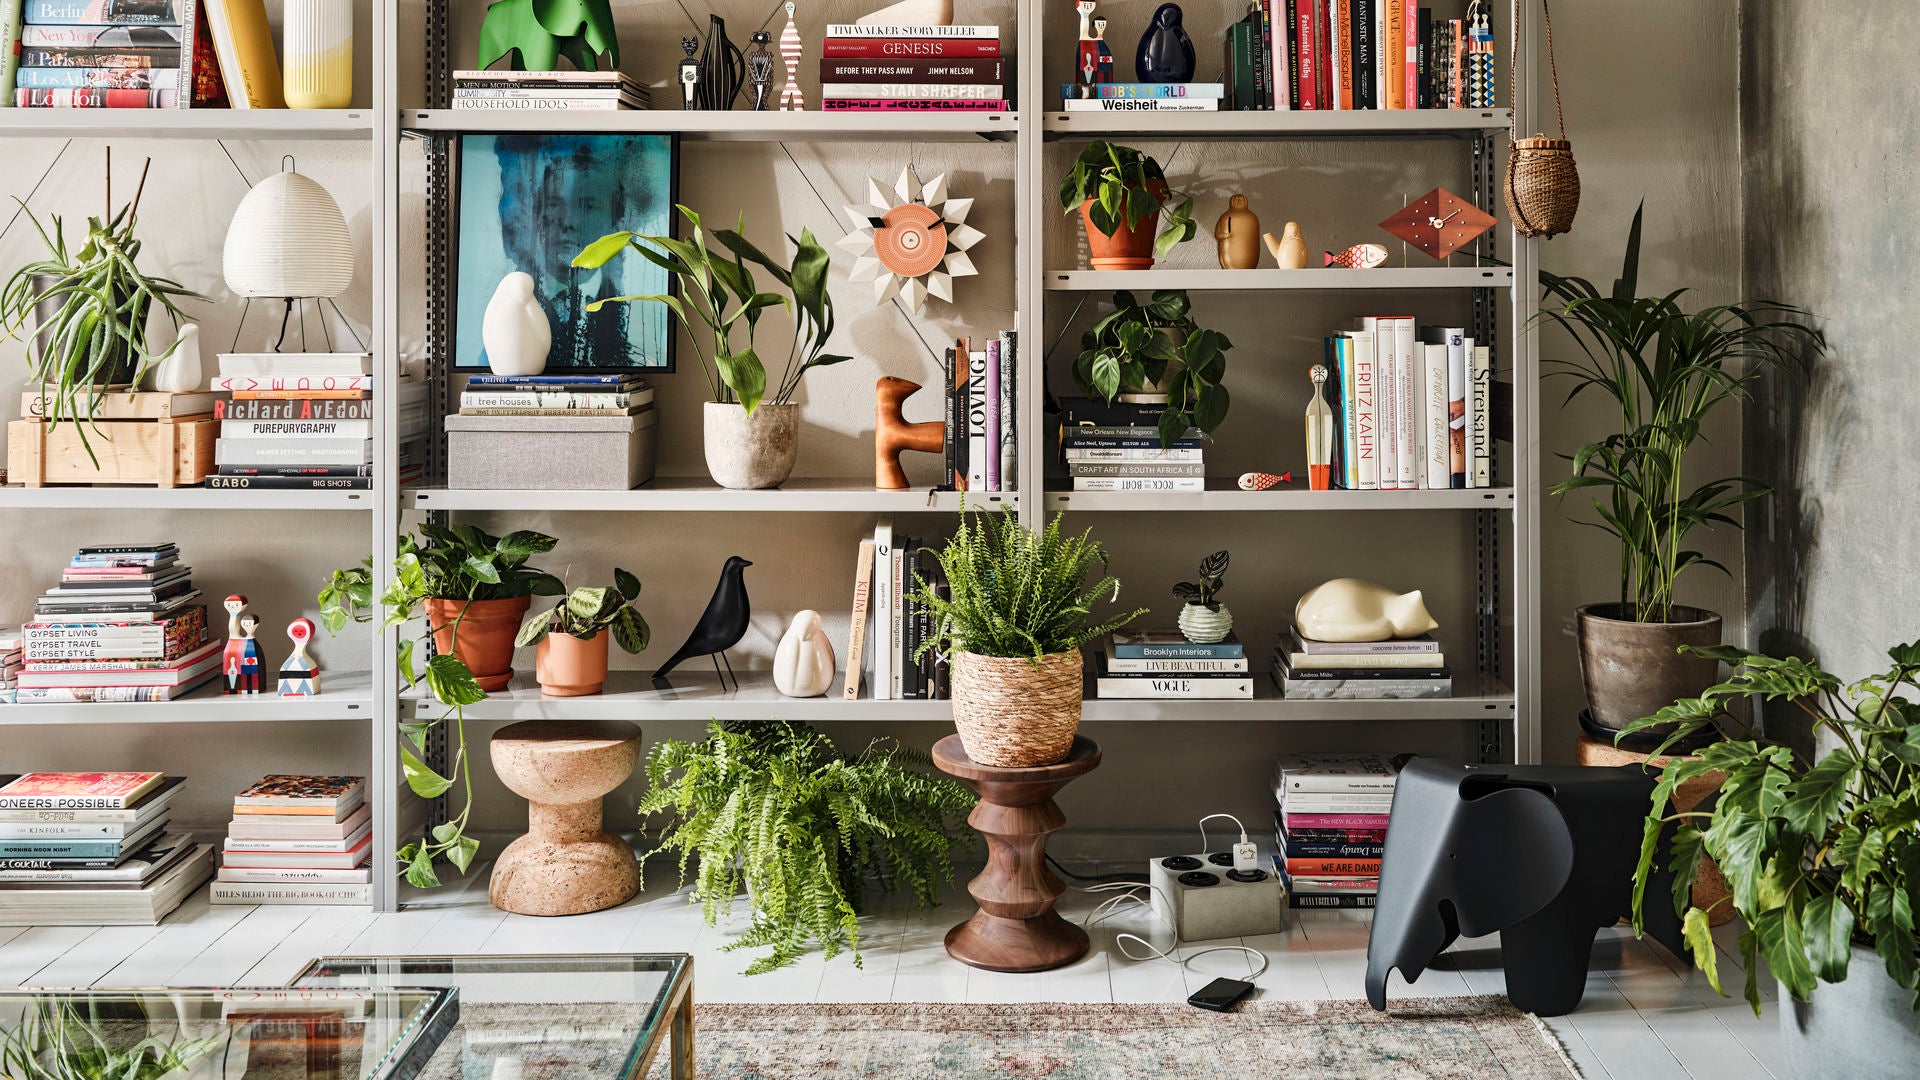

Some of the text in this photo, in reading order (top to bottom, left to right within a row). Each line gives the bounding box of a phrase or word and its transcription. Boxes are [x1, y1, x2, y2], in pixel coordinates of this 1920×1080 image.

[40, 3, 86, 18] Berlin
[1390, 0, 1401, 34] GRACE
[1359, 1, 1367, 42] FANTASTIC
[37, 29, 65, 43] New
[833, 25, 975, 36] TIM WALKER STORY TELLER
[184, 24, 192, 56] DAGMAR
[1302, 14, 1311, 78] Fashionable Selby
[883, 42, 943, 55] GENESIS
[39, 52, 75, 67] Paris
[878, 67, 894, 75] PASS
[895, 67, 914, 75] AWAY
[928, 67, 974, 75] JIMMY NELSON
[1341, 50, 1350, 90] Basquiat
[32, 71, 58, 86] Los
[182, 73, 190, 96] TAUBE
[457, 90, 506, 98] LUMINOSITY
[881, 84, 985, 98] STAN SHAFFER
[1102, 85, 1137, 98] BOB'S
[31, 90, 101, 107] London
[456, 99, 569, 109] HOUSEHOLD IDOLS
[824, 100, 998, 109] HOTEL LACHAPELLE
[1101, 99, 1158, 111] Weisheit
[478, 393, 531, 406] tree houses
[970, 358, 986, 439] LOVING
[214, 400, 371, 419] RicHard AvEdoN
[1357, 362, 1374, 459] FRITZ KAHN
[1474, 368, 1490, 458] Streisand
[253, 423, 337, 434] PUREPURYGRAPHY
[1120, 466, 1128, 474] IN
[212, 478, 250, 488] GABO
[1122, 480, 1142, 490] BOAT
[1152, 480, 1174, 490] ROCK
[854, 581, 868, 613] KILIM
[1144, 648, 1178, 656] Brooklyn
[1146, 662, 1226, 670] LIVE BEAUTIFUL
[1152, 680, 1190, 692] VOGUE
[58, 799, 120, 808] POSSIBLE
[1340, 845, 1370, 855] Dandy
[1321, 864, 1333, 872] WE
[1337, 864, 1352, 872] ARE
[216, 890, 240, 898] MILES
[242, 890, 264, 898] REDD
